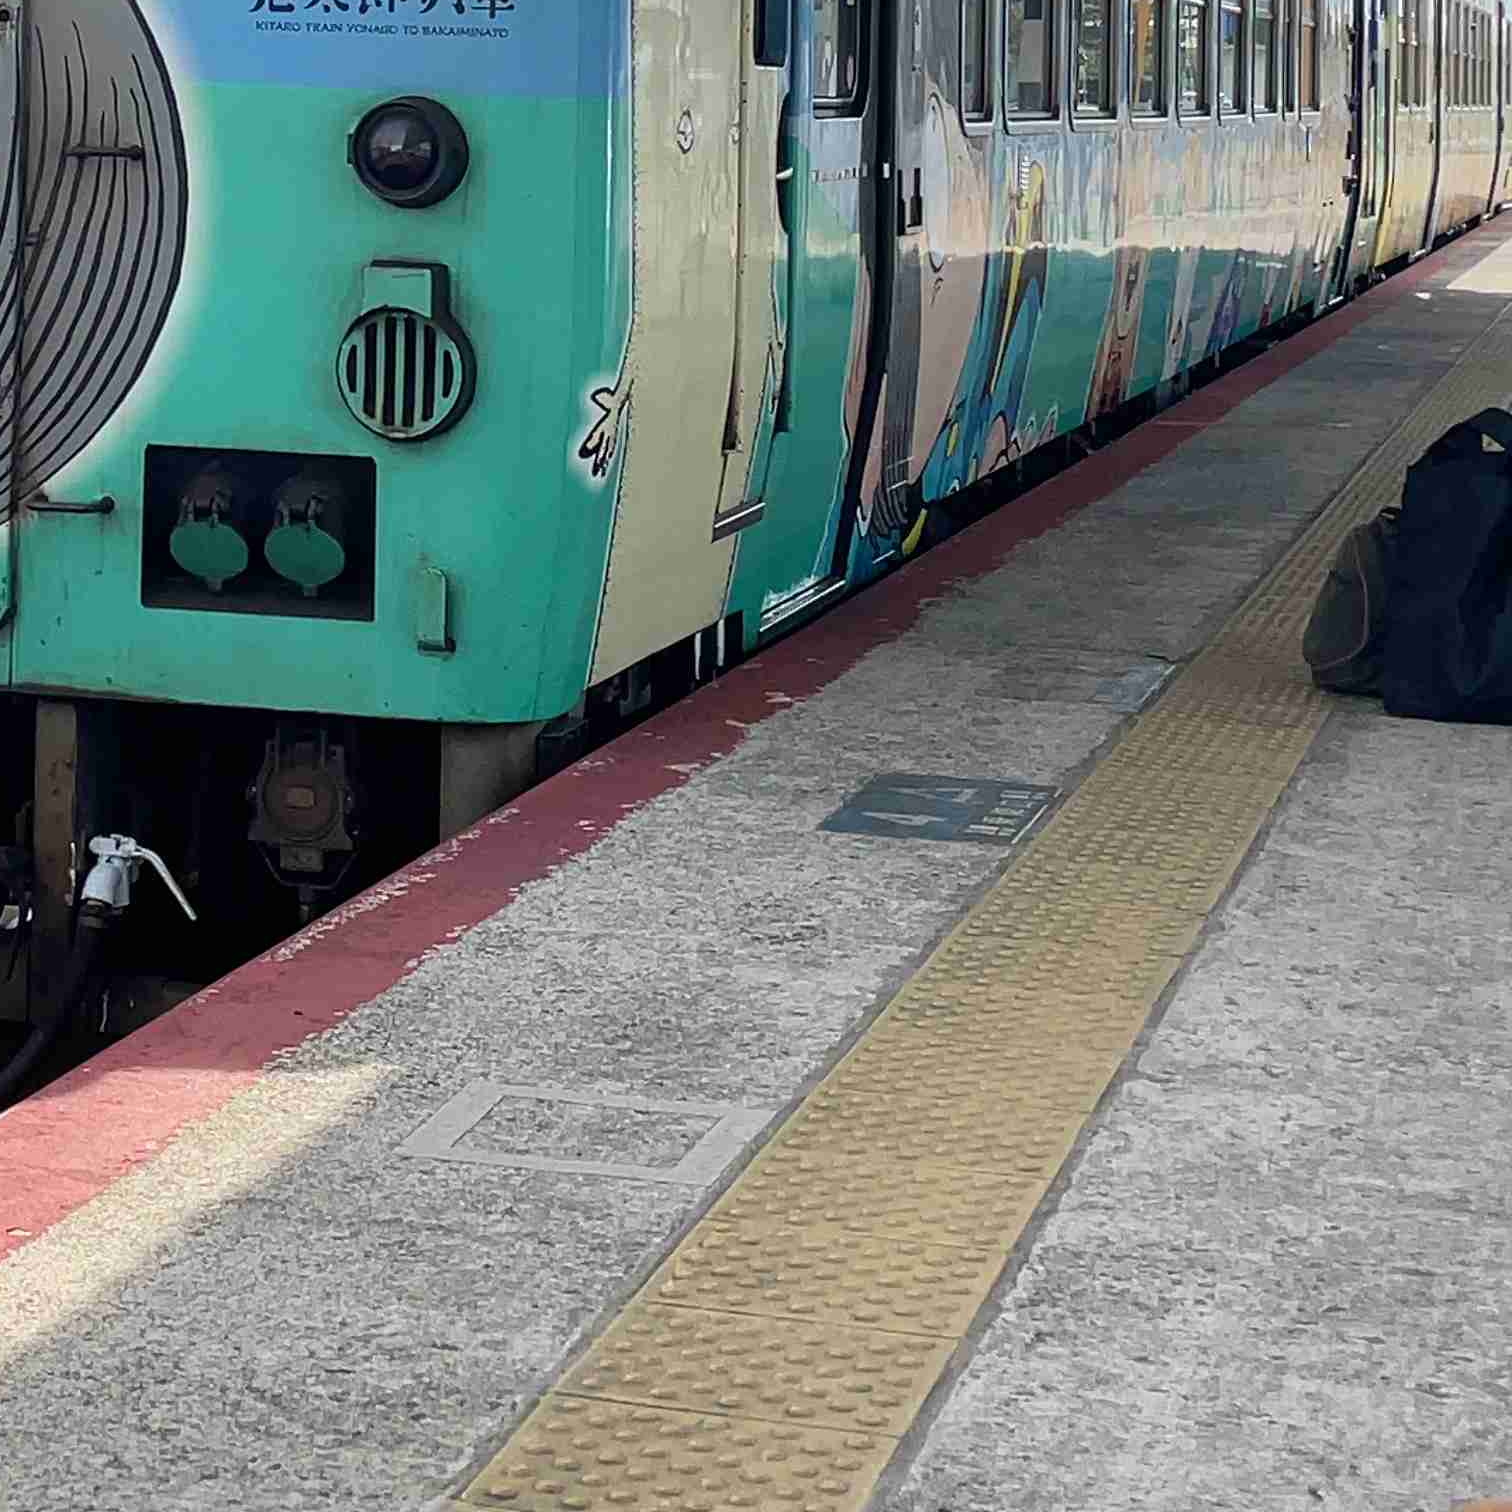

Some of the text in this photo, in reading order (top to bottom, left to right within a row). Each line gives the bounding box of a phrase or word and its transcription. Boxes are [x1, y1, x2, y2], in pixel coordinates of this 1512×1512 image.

[255, 20, 300, 33] KITARO
[306, 22, 343, 33] TRAIN
[346, 23, 399, 35] YONAGO
[403, 25, 419, 36] TO
